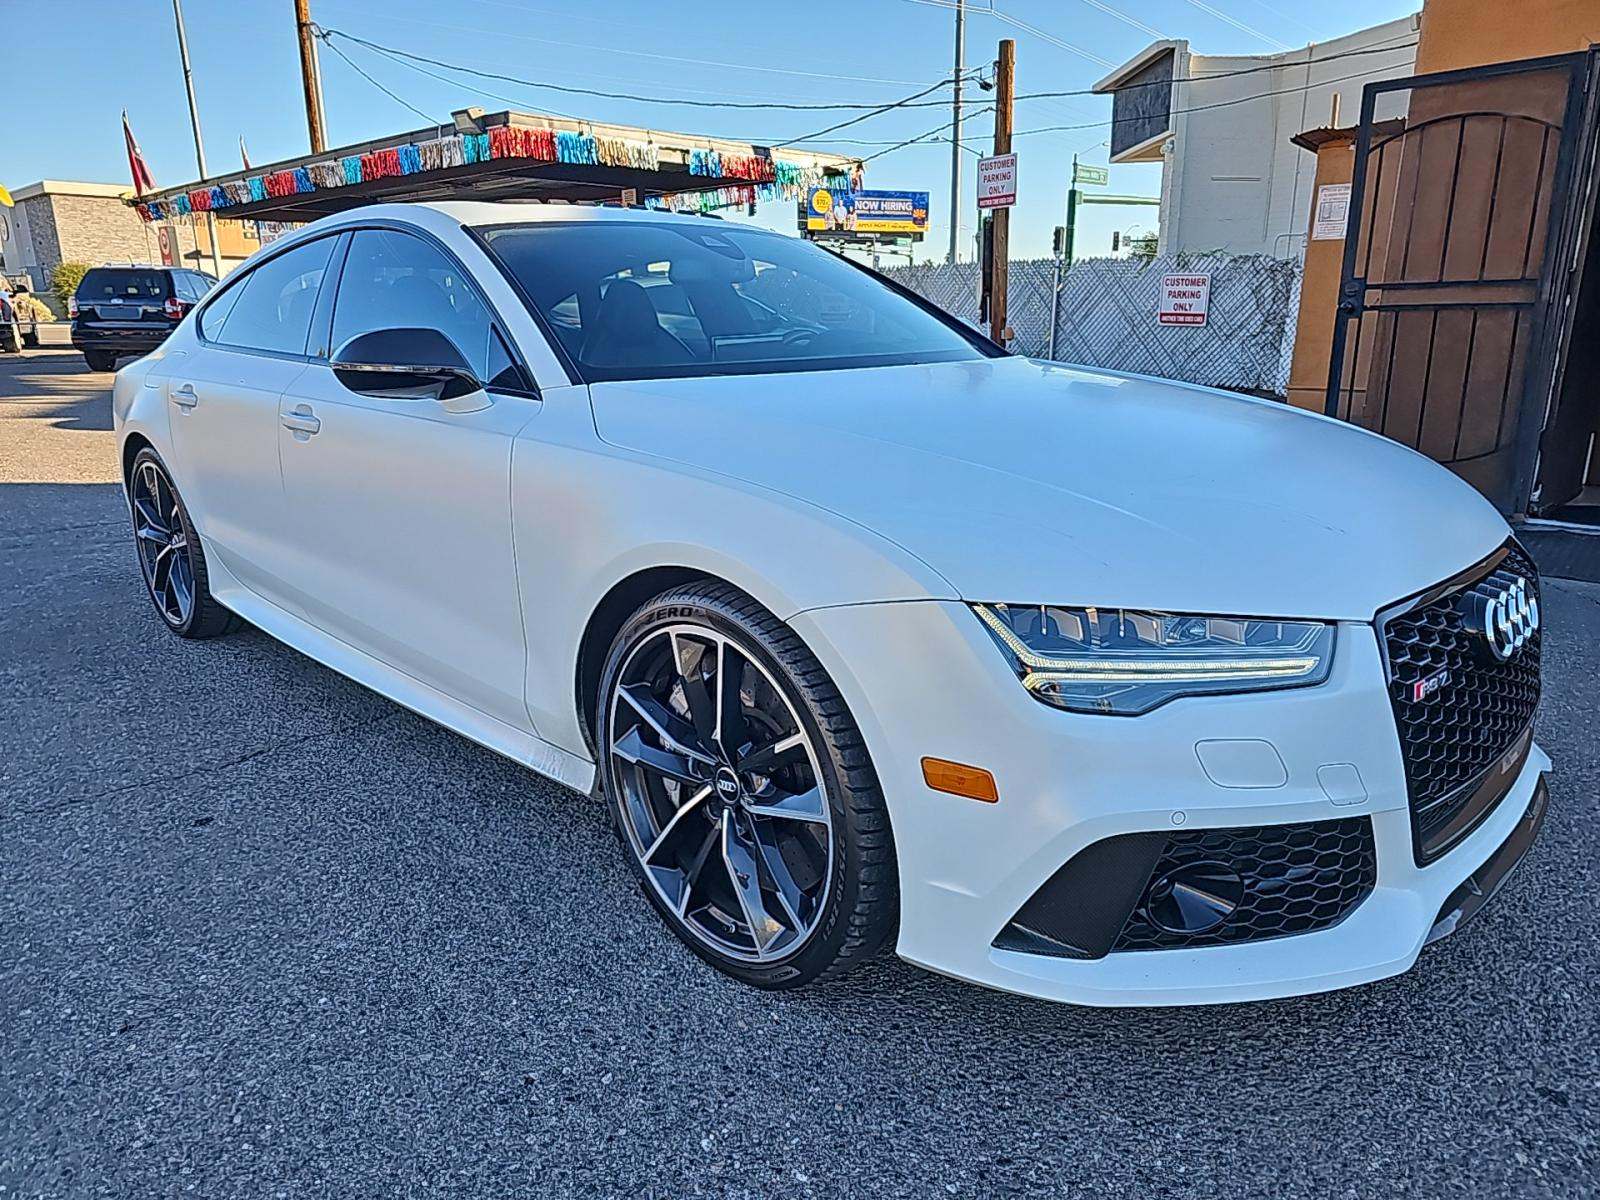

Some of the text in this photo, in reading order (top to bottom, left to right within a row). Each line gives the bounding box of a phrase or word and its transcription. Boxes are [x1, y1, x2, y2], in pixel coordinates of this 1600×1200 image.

[980, 159, 1015, 172] CUSTOMER
[983, 171, 1011, 183] PARKING
[988, 184, 1005, 195] ONLY
[855, 201, 912, 211] NOW HIRING
[1164, 278, 1207, 287] CUSTOMER
[1167, 290, 1202, 299] PARKING
[1173, 302, 1193, 312] ONLY
